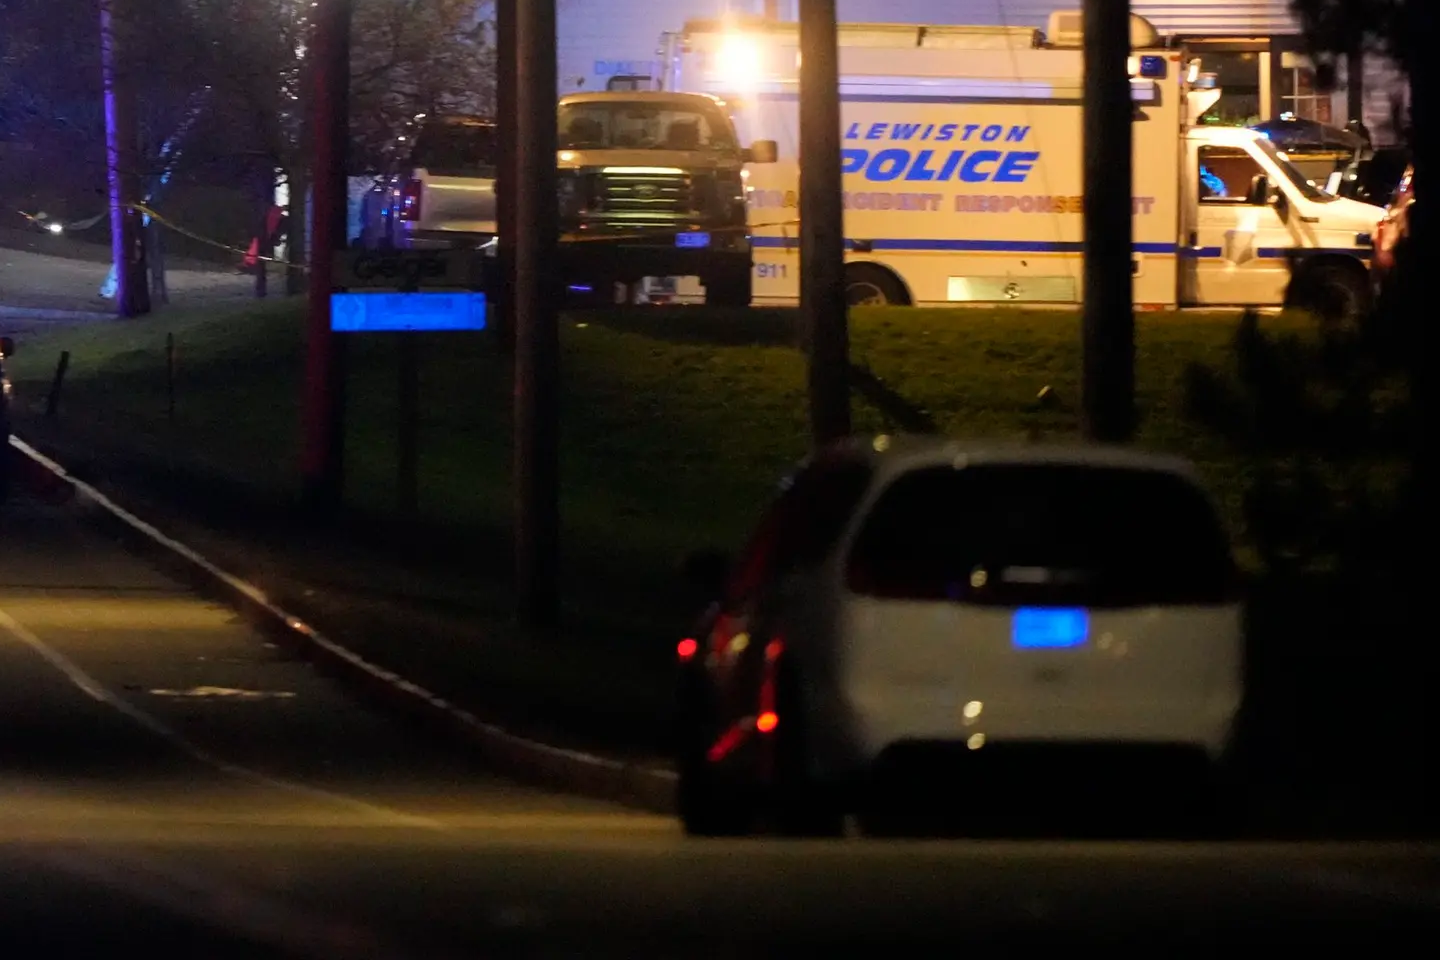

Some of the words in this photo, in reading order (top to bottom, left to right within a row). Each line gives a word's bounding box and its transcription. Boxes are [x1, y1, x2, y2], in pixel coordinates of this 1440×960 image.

[844, 122, 1032, 142] LEWISTON
[955, 195, 1084, 214] RESPONSE
[757, 263, 787, 278] 911
